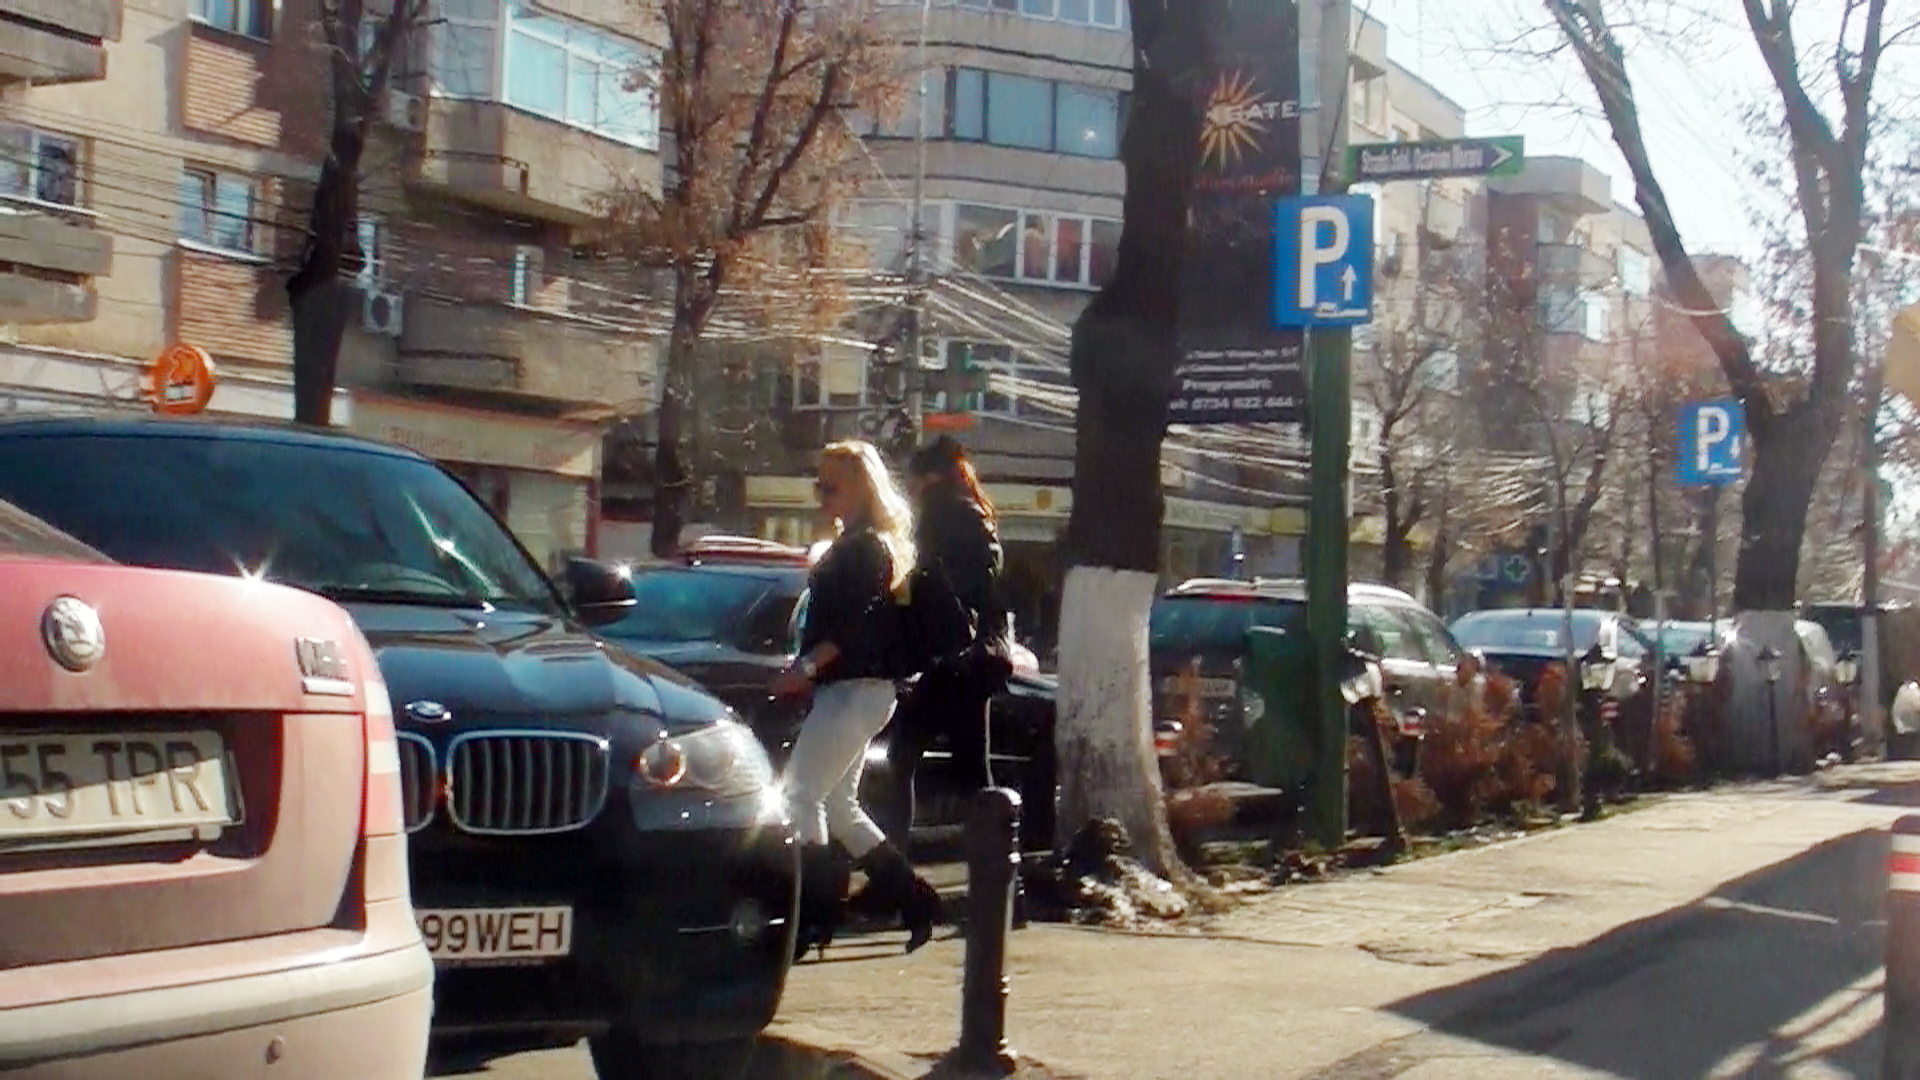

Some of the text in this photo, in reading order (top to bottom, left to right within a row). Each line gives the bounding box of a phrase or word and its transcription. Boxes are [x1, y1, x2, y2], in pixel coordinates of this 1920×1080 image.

[1299, 205, 1350, 308] P
[1697, 406, 1730, 471] P
[92, 740, 209, 816] TPR
